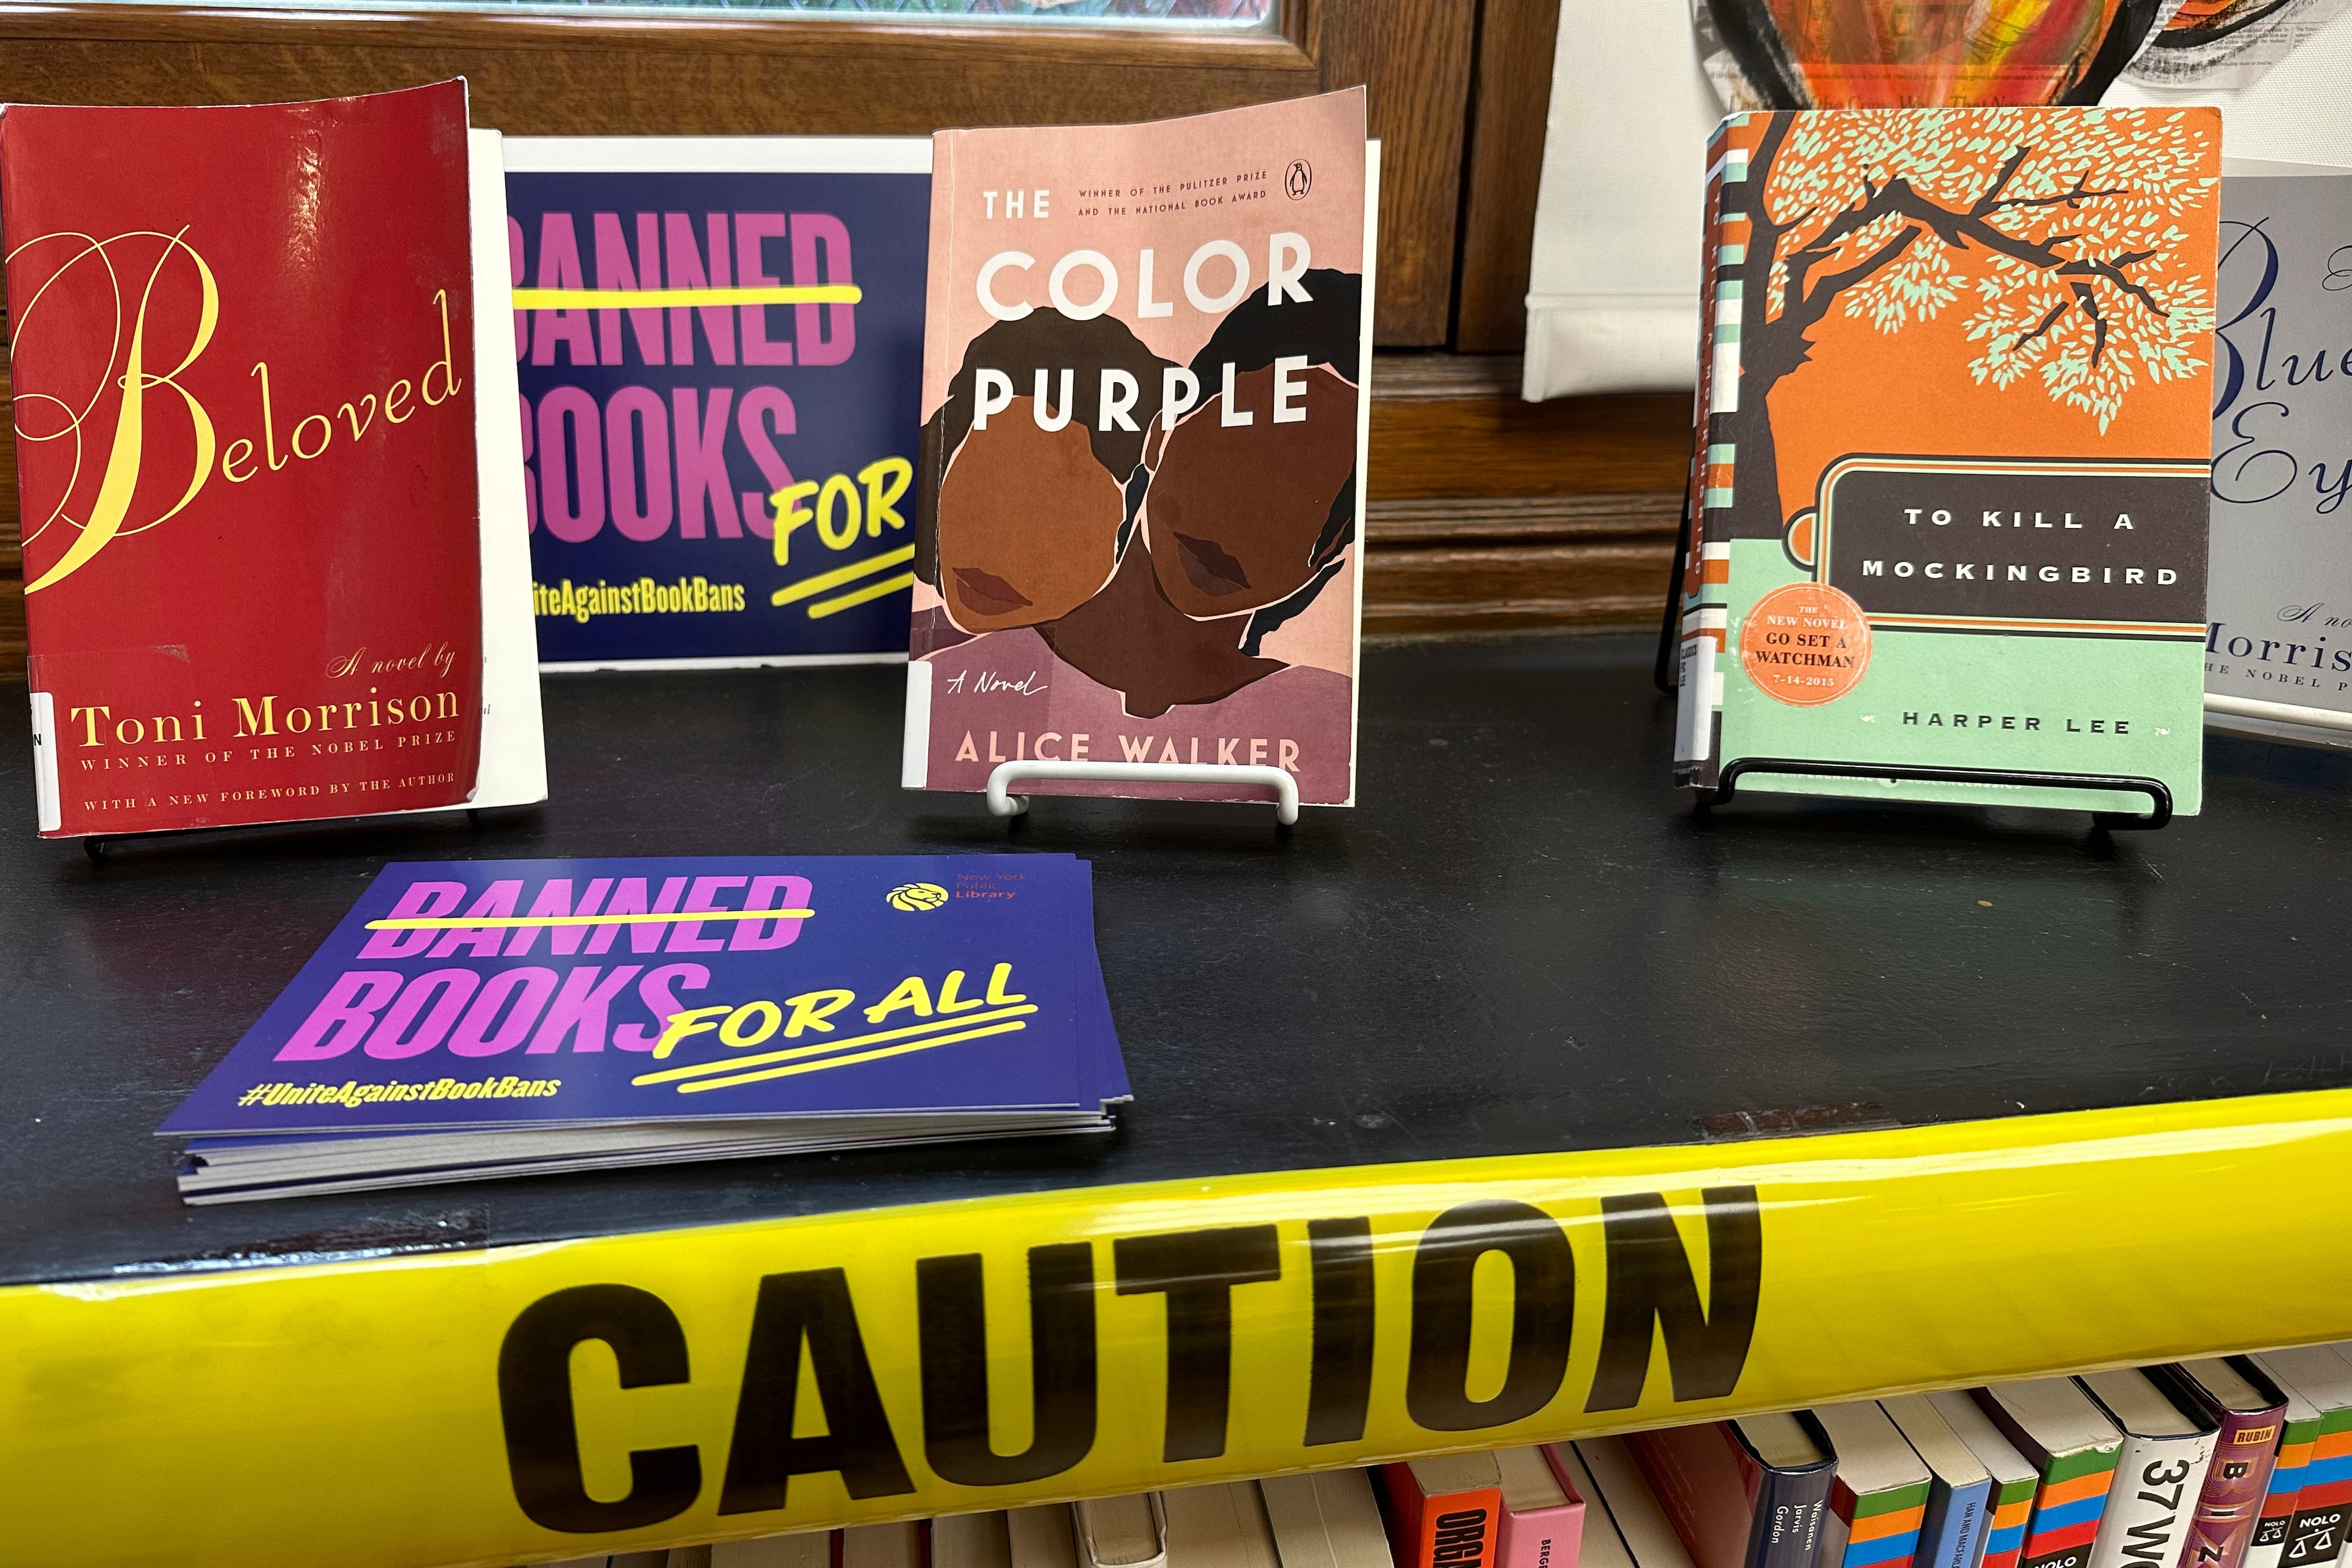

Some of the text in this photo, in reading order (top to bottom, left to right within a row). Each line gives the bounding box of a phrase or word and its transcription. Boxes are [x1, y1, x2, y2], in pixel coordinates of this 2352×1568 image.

[1079, 171, 1267, 198] WINNER OF THE PULITZER PRIZE
[983, 190, 1050, 219] THE
[1136, 202, 1186, 214] NATIONAL
[1195, 196, 1224, 208] BOOK
[1232, 190, 1266, 203] AWARD
[976, 231, 1314, 321] COLOR
[973, 354, 1308, 432] PURPLE
[5, 224, 462, 595] Beloved
[770, 456, 914, 565] FOR
[1904, 508, 2134, 530] TO KILL A
[1862, 560, 2177, 586] MOCKINGBIRD
[1766, 615, 1848, 629] NEW NOVEL
[1798, 606, 1819, 614] THE
[2277, 603, 2324, 622] A
[1681, 644, 1697, 660] CLASSICS
[1766, 632, 1847, 648] GO SET A
[326, 641, 456, 679] A novel by
[1755, 650, 1855, 668] WATCHMAN
[947, 669, 1048, 696] A Novel
[1773, 674, 1834, 687] 7-14-2015
[2245, 669, 2320, 688] NOBEL
[70, 687, 460, 747] Toni Morrison
[1902, 712, 2130, 736] HARPER LEE
[81, 731, 455, 771] WINNER OF THE NOBEL PRIZE
[954, 730, 1300, 772] ALICE WALKER
[85, 772, 455, 811] WITH A NEW FOREWORD BY THE AUTHOR
[956, 891, 1016, 899] Library
[355, 875, 813, 959] BANNED
[273, 963, 710, 1061] BOOKS
[652, 962, 1027, 1060] FOR ALL
[237, 1076, 562, 1108] #UniteAgainstBookBans
[497, 1184, 1763, 1533] CAUTION
[2236, 1428, 2274, 1442] RUBIN
[2137, 1459, 2190, 1510] 37
[1792, 1505, 1806, 1534] Jarvis
[1964, 1501, 1976, 1518] HAN
[2299, 1513, 2341, 1528] NOLO
[1771, 1506, 1789, 1544] Gordon
[1804, 1499, 1823, 1551] Waisanen
[1960, 1519, 1972, 1536] AND
